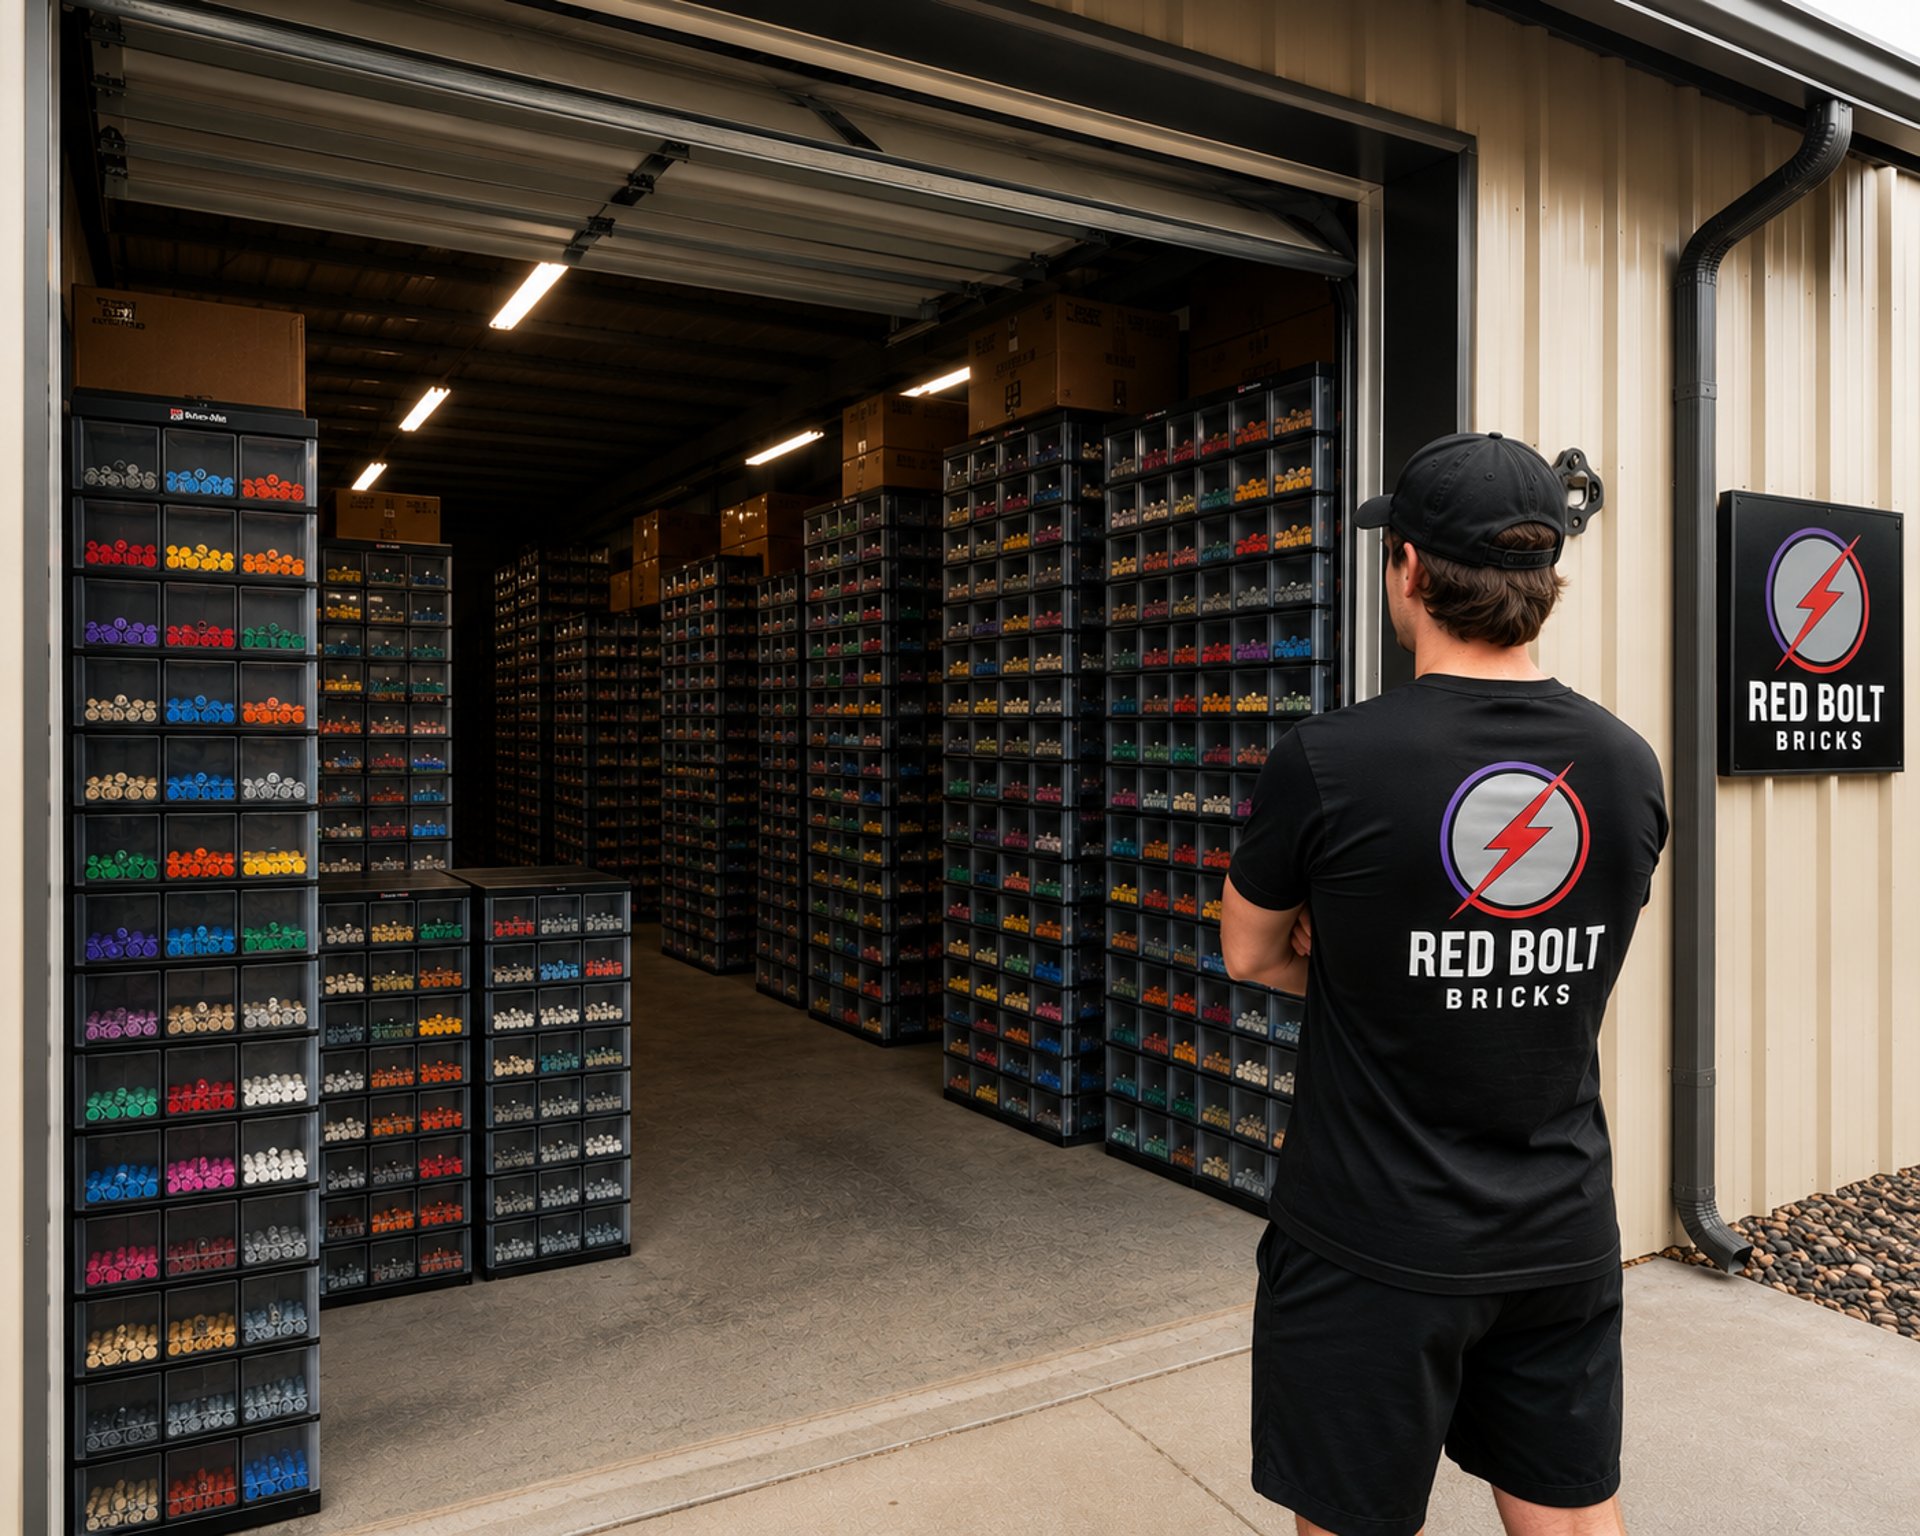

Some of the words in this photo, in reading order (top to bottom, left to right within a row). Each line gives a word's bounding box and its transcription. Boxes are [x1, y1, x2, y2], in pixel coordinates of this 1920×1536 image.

[1748, 680, 1808, 723] RED
[1817, 683, 1886, 723] BOLT
[1776, 730, 1862, 751] BRICKS
[1408, 930, 1495, 978] RED
[1509, 924, 1606, 976] BOLT
[1446, 983, 1570, 1010] BRICKS
